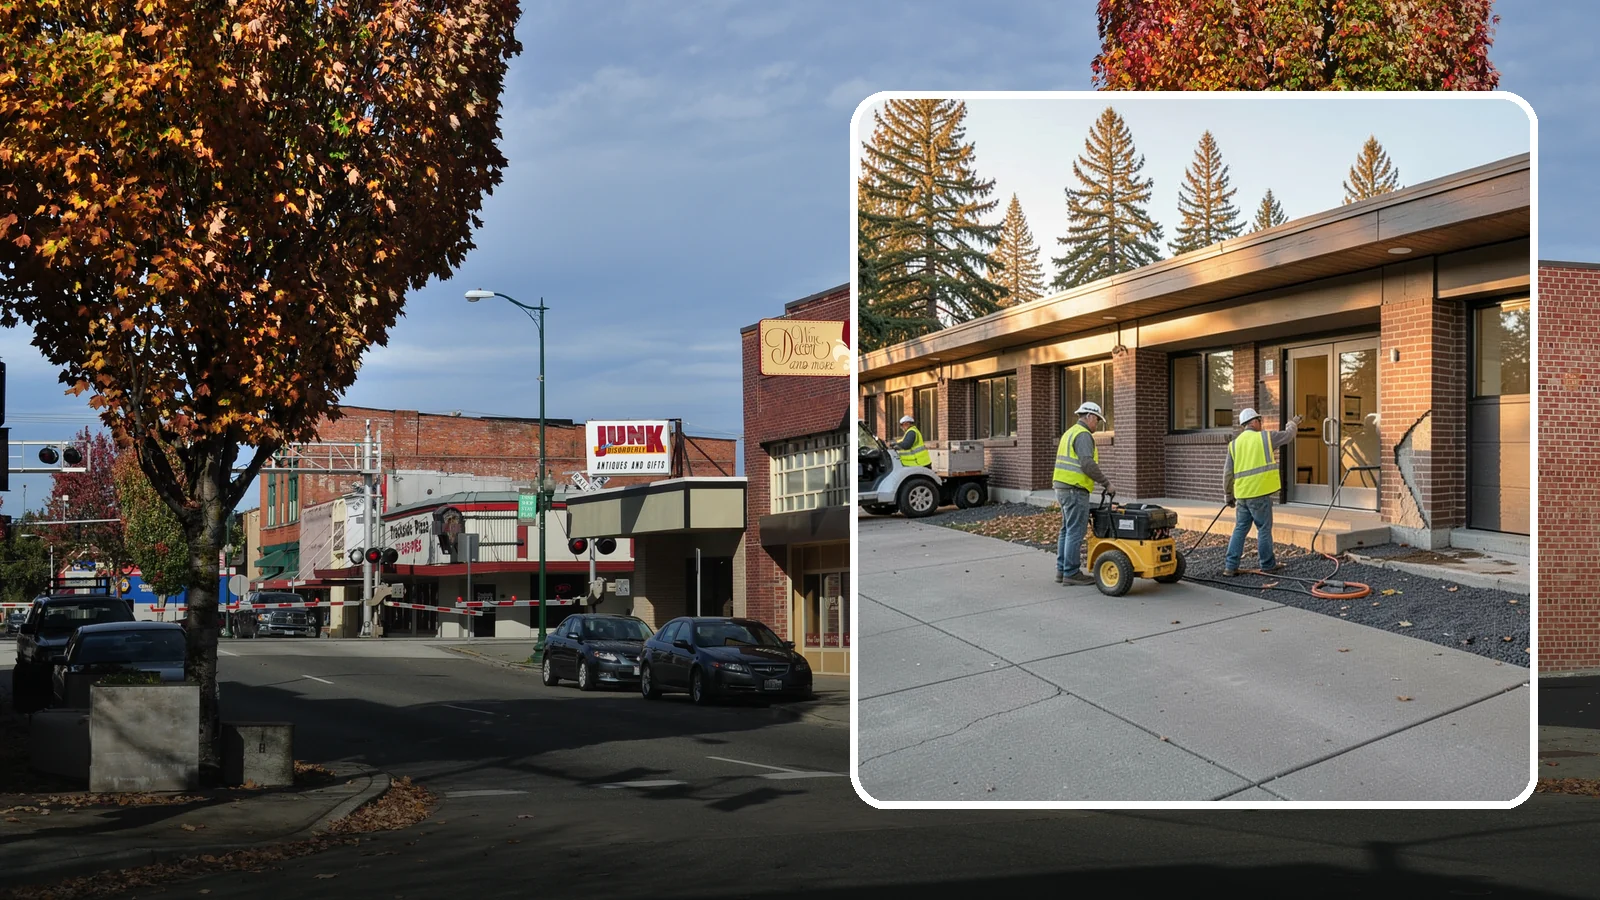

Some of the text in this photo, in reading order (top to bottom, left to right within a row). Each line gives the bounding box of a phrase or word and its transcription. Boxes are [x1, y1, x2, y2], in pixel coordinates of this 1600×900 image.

[595, 425, 665, 457] JUNK
[608, 446, 646, 454] DISORDERLY
[596, 460, 665, 470] ANTIQUES AND GIFTS
[414, 519, 429, 535] Pizza
